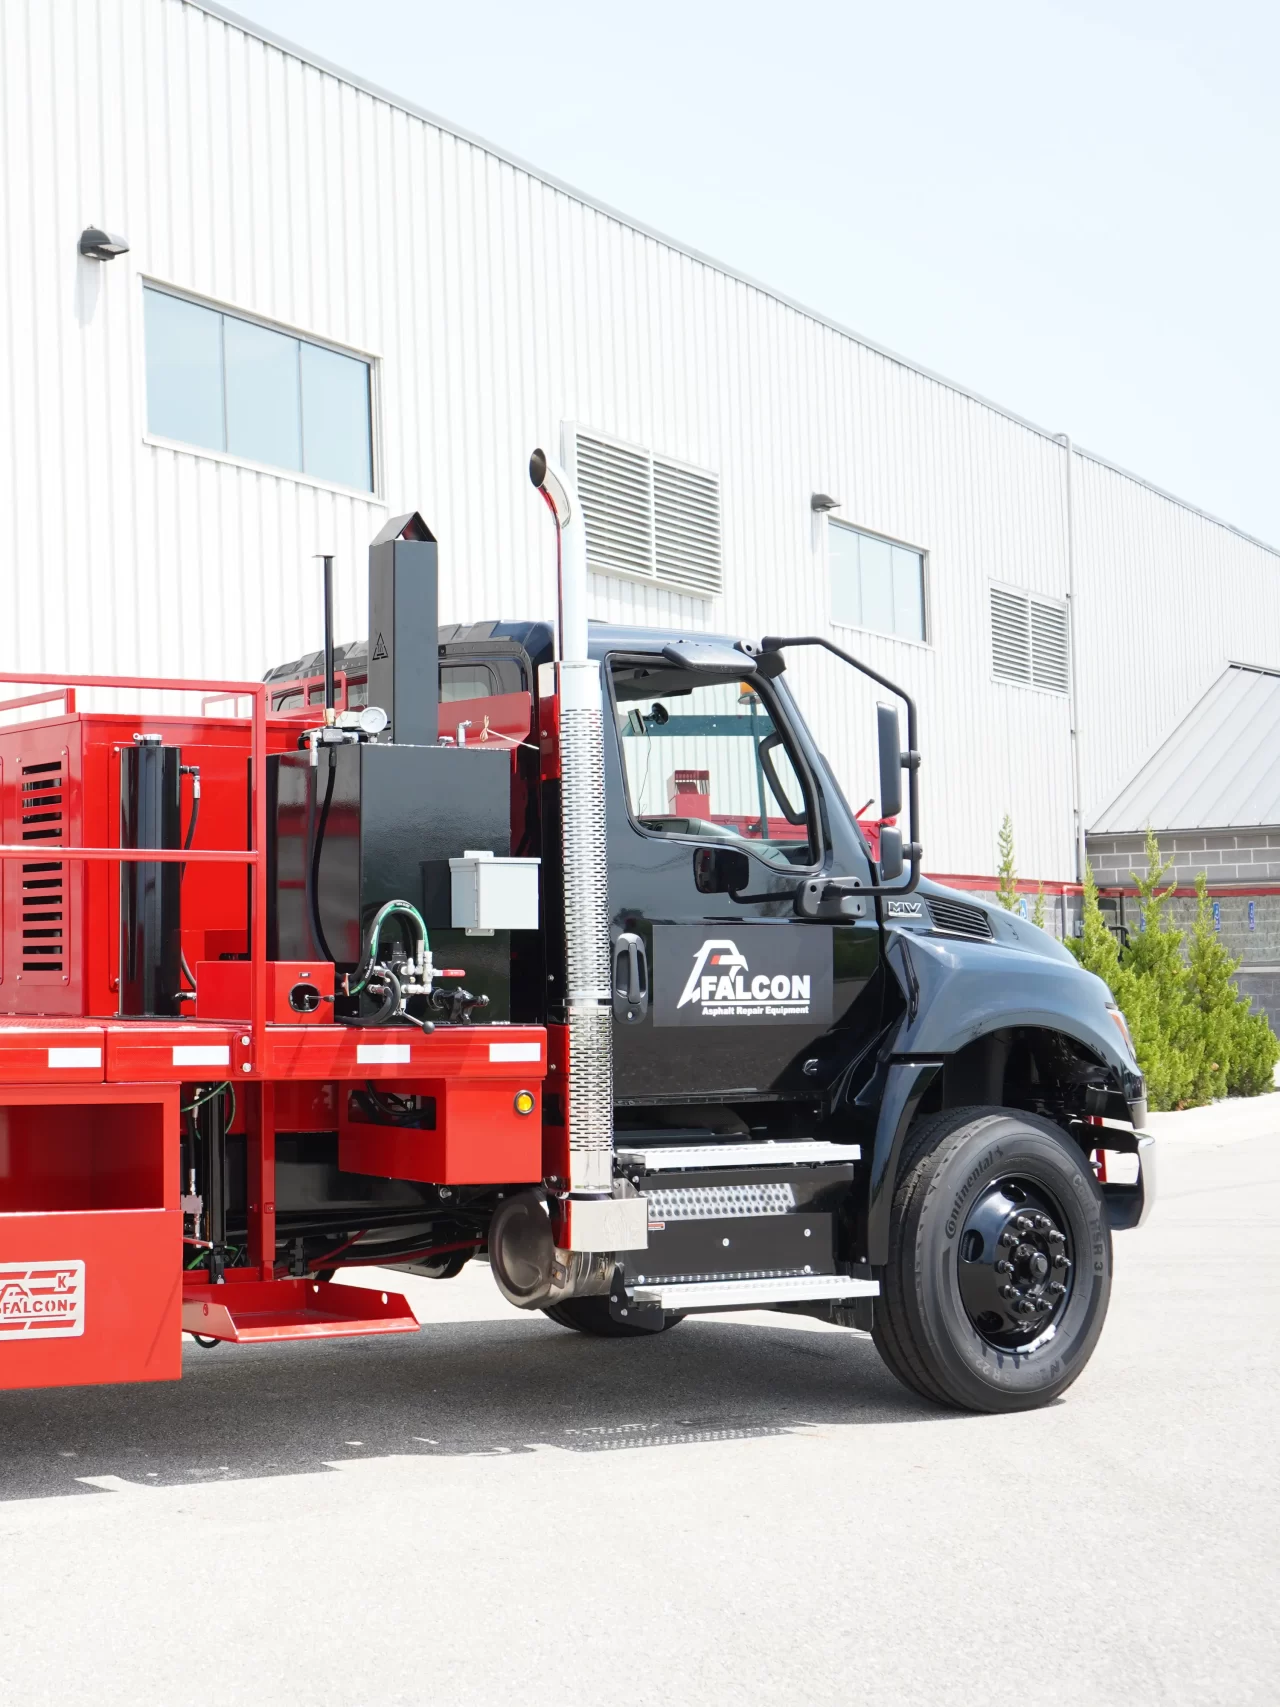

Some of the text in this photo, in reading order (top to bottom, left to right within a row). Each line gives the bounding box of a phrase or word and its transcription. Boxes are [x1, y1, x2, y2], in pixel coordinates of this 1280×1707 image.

[887, 901, 921, 914] MV
[701, 974, 810, 1000] FALCON
[702, 1005, 809, 1017] Asphalt Repair Equipment
[944, 1151, 994, 1240] Continental
[58, 1275, 67, 1288] K
[3, 1299, 67, 1314] FALCON
